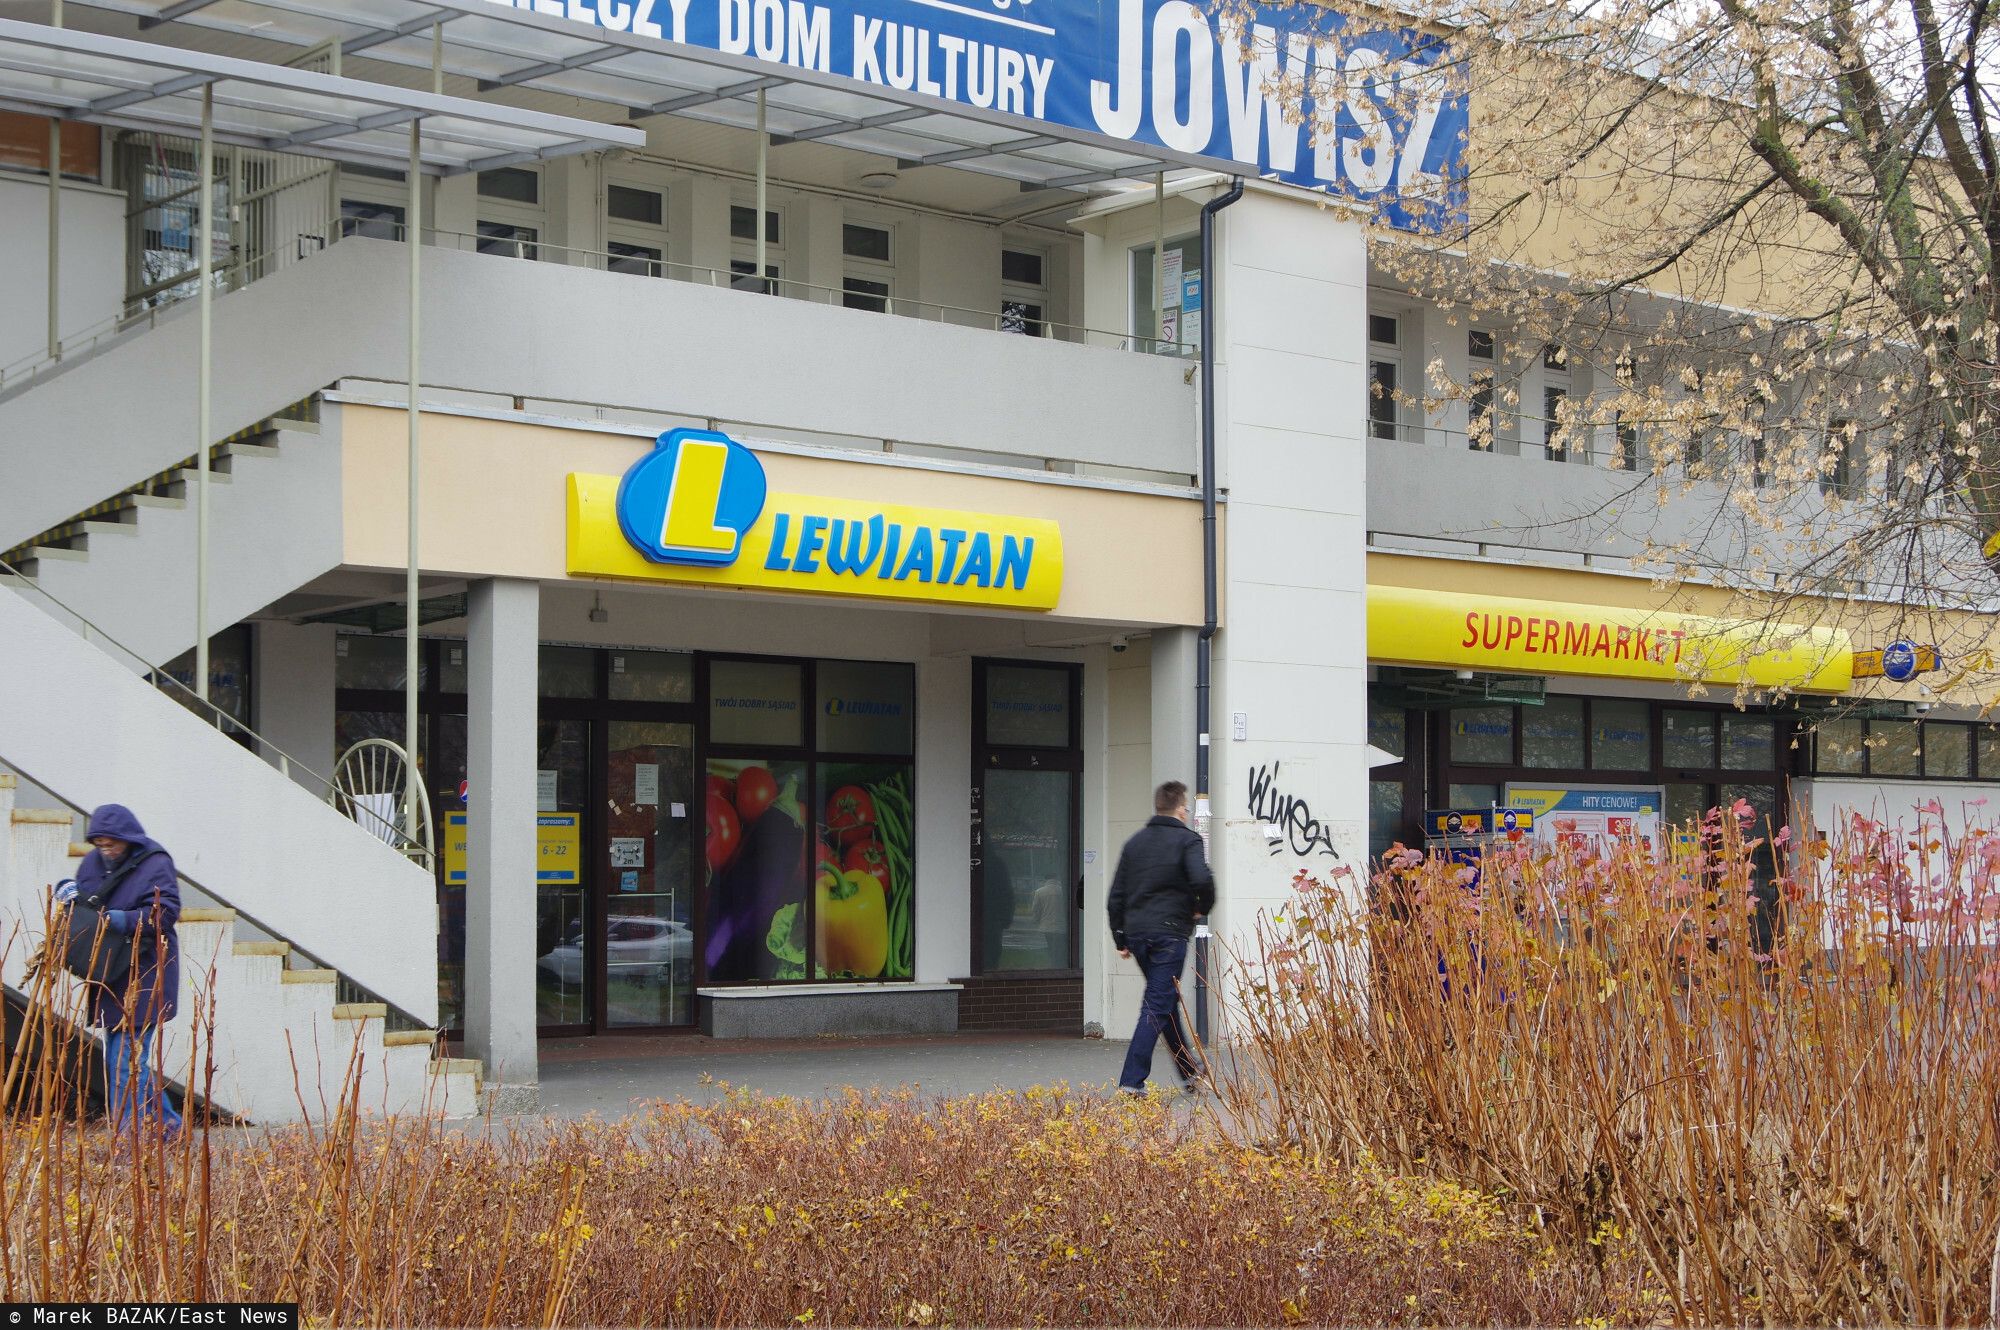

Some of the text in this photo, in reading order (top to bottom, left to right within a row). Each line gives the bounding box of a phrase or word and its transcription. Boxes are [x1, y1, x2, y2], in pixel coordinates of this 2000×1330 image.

[719, 0, 830, 73] DOM
[854, 14, 1055, 119] KULTURY
[1090, 0, 1447, 204] JOWISZ
[764, 513, 1034, 590] LEWIATAN
[1462, 612, 1686, 664] SUPERMARKET
[1582, 796, 1637, 809] HITY CENOWE!
